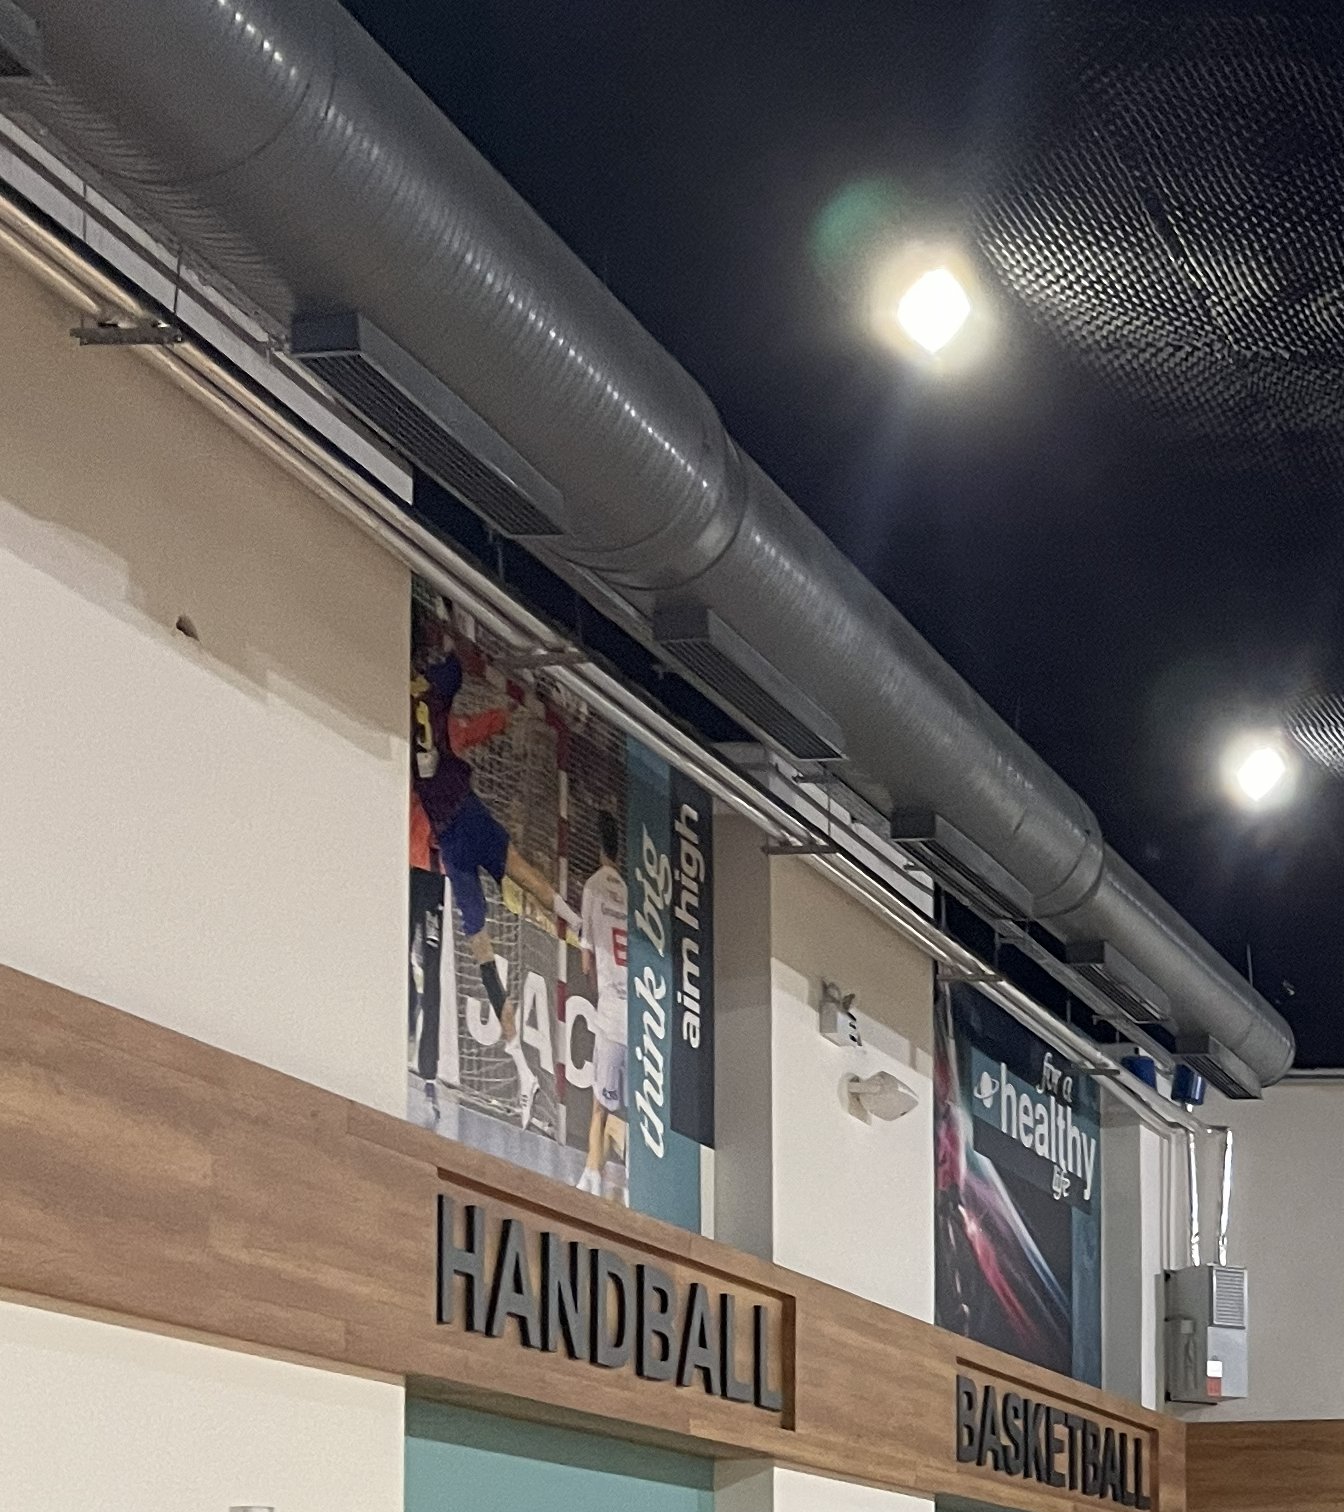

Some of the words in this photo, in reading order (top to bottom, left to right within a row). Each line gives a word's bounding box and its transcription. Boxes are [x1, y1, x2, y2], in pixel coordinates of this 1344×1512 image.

[635, 822, 673, 958] big
[675, 803, 704, 930] high
[677, 937, 701, 1048] aim
[634, 966, 668, 1158] think
[1000, 1062, 1096, 1200] healthy
[437, 1194, 784, 1412] HANDBALL
[956, 1373, 1151, 1511] BASKETBALL
